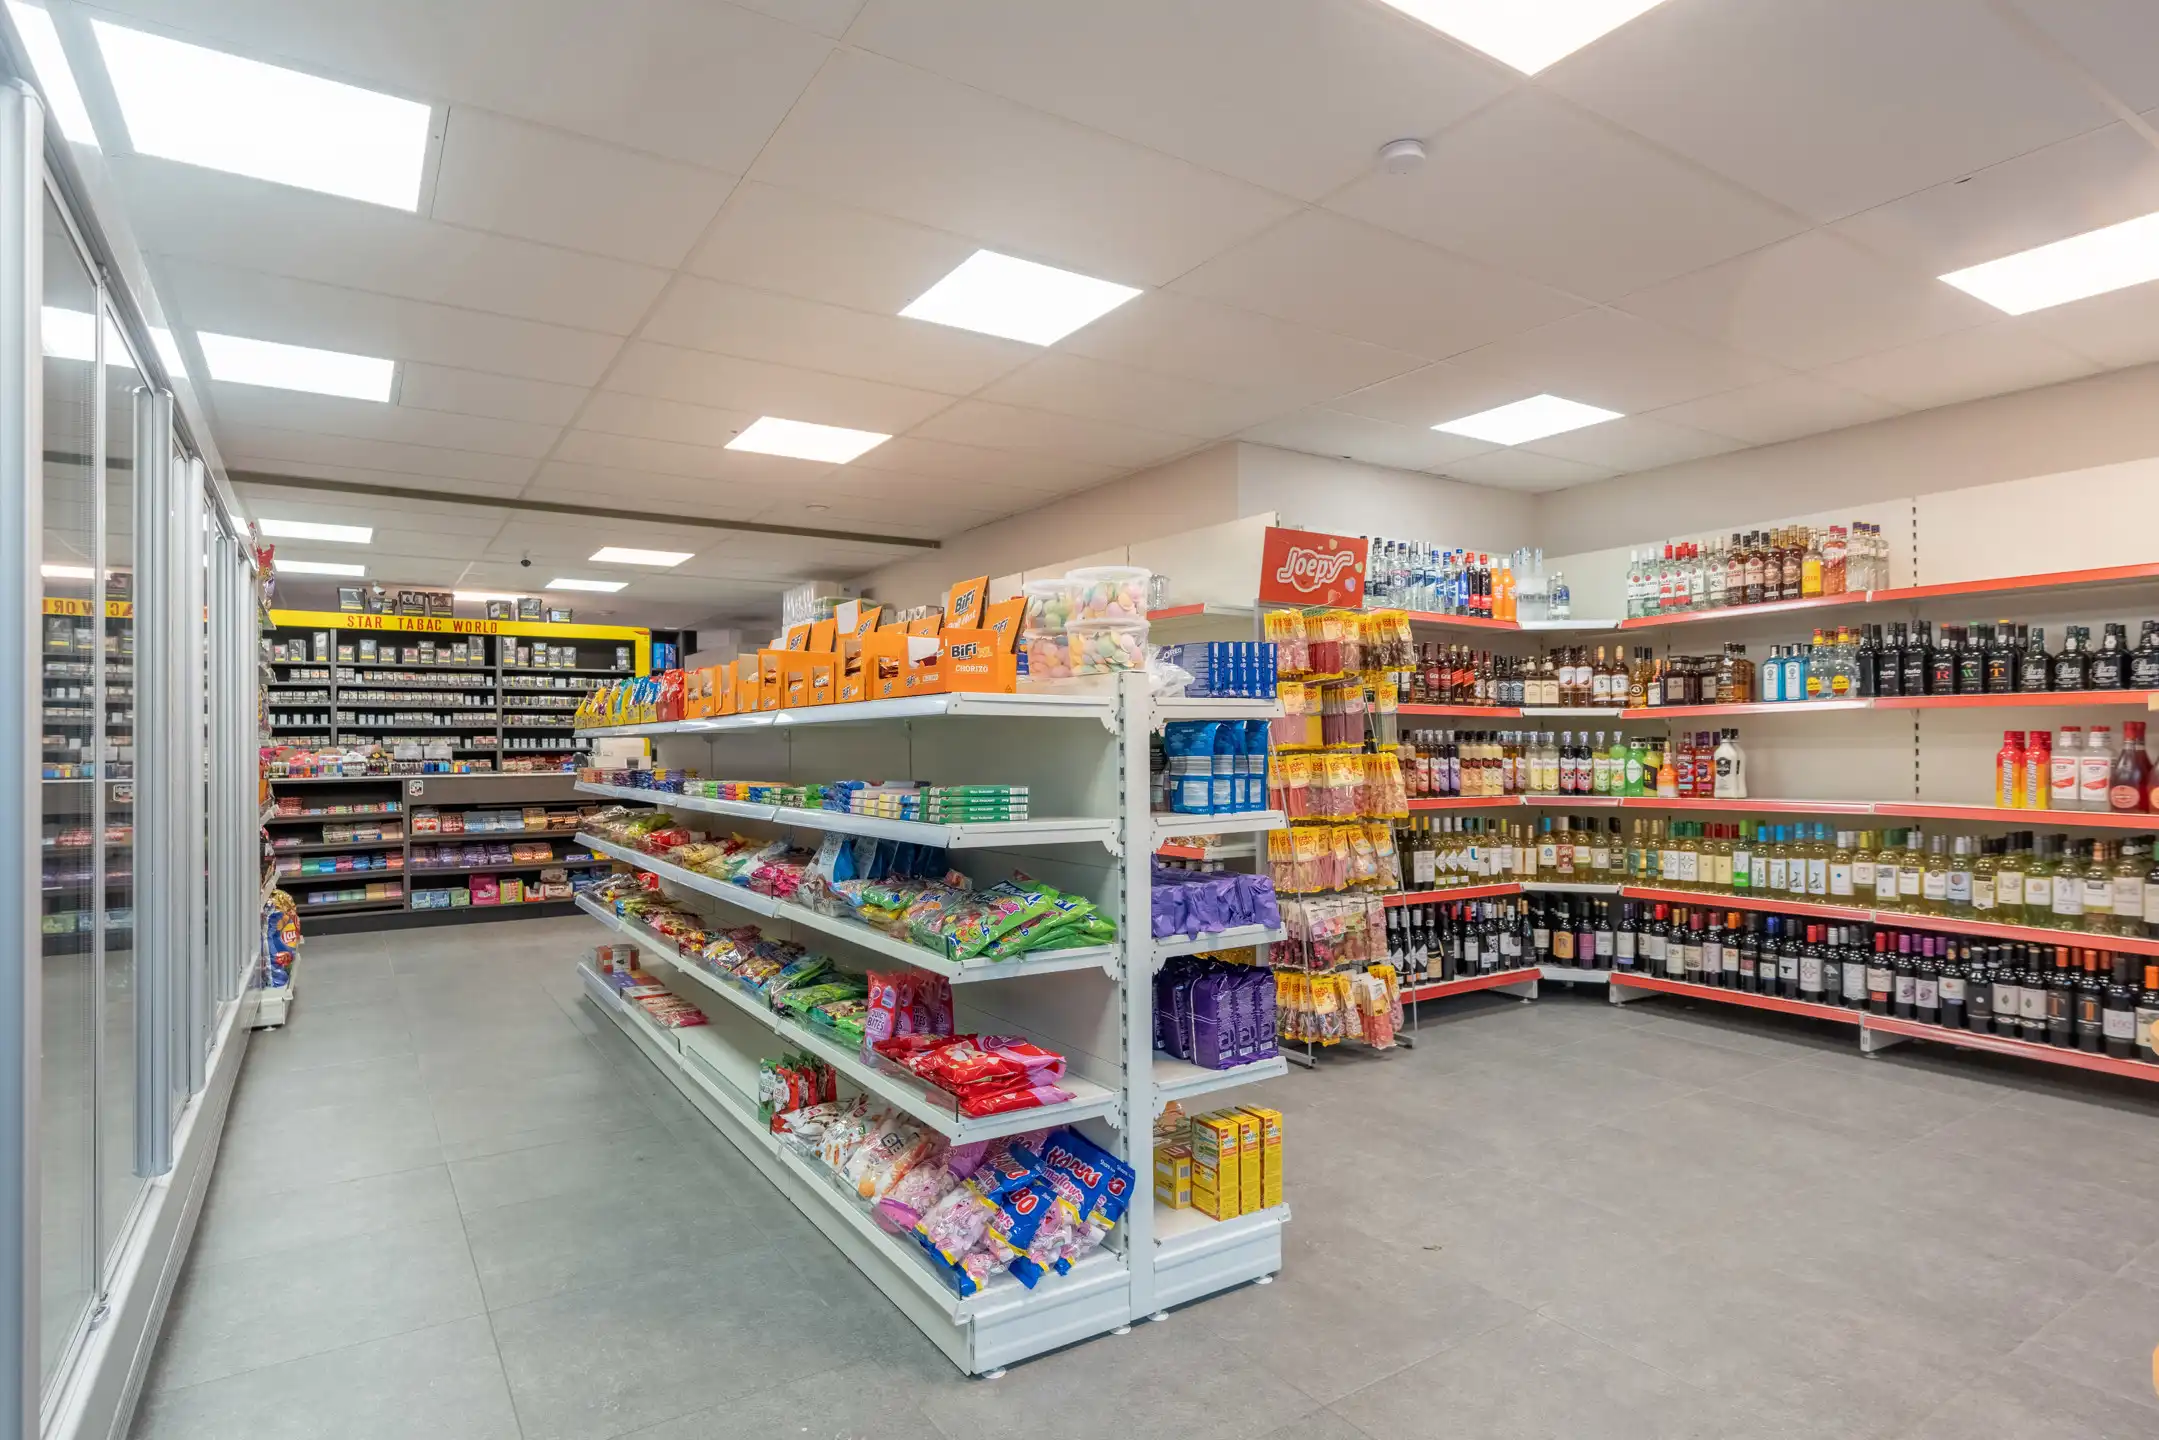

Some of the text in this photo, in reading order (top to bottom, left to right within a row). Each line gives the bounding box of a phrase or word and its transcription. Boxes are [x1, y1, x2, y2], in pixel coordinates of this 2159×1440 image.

[1279, 550, 1352, 586] Joepy
[953, 588, 976, 615] BiFi
[347, 615, 498, 634] STAR TABAC WORLD
[951, 642, 978, 658] BiFi
[955, 664, 989, 673] CHORIZO
[1936, 671, 1950, 680] R
[1989, 667, 2005, 677] T
[871, 1010, 887, 1019] JUICY
[867, 1016, 885, 1031] BITES
